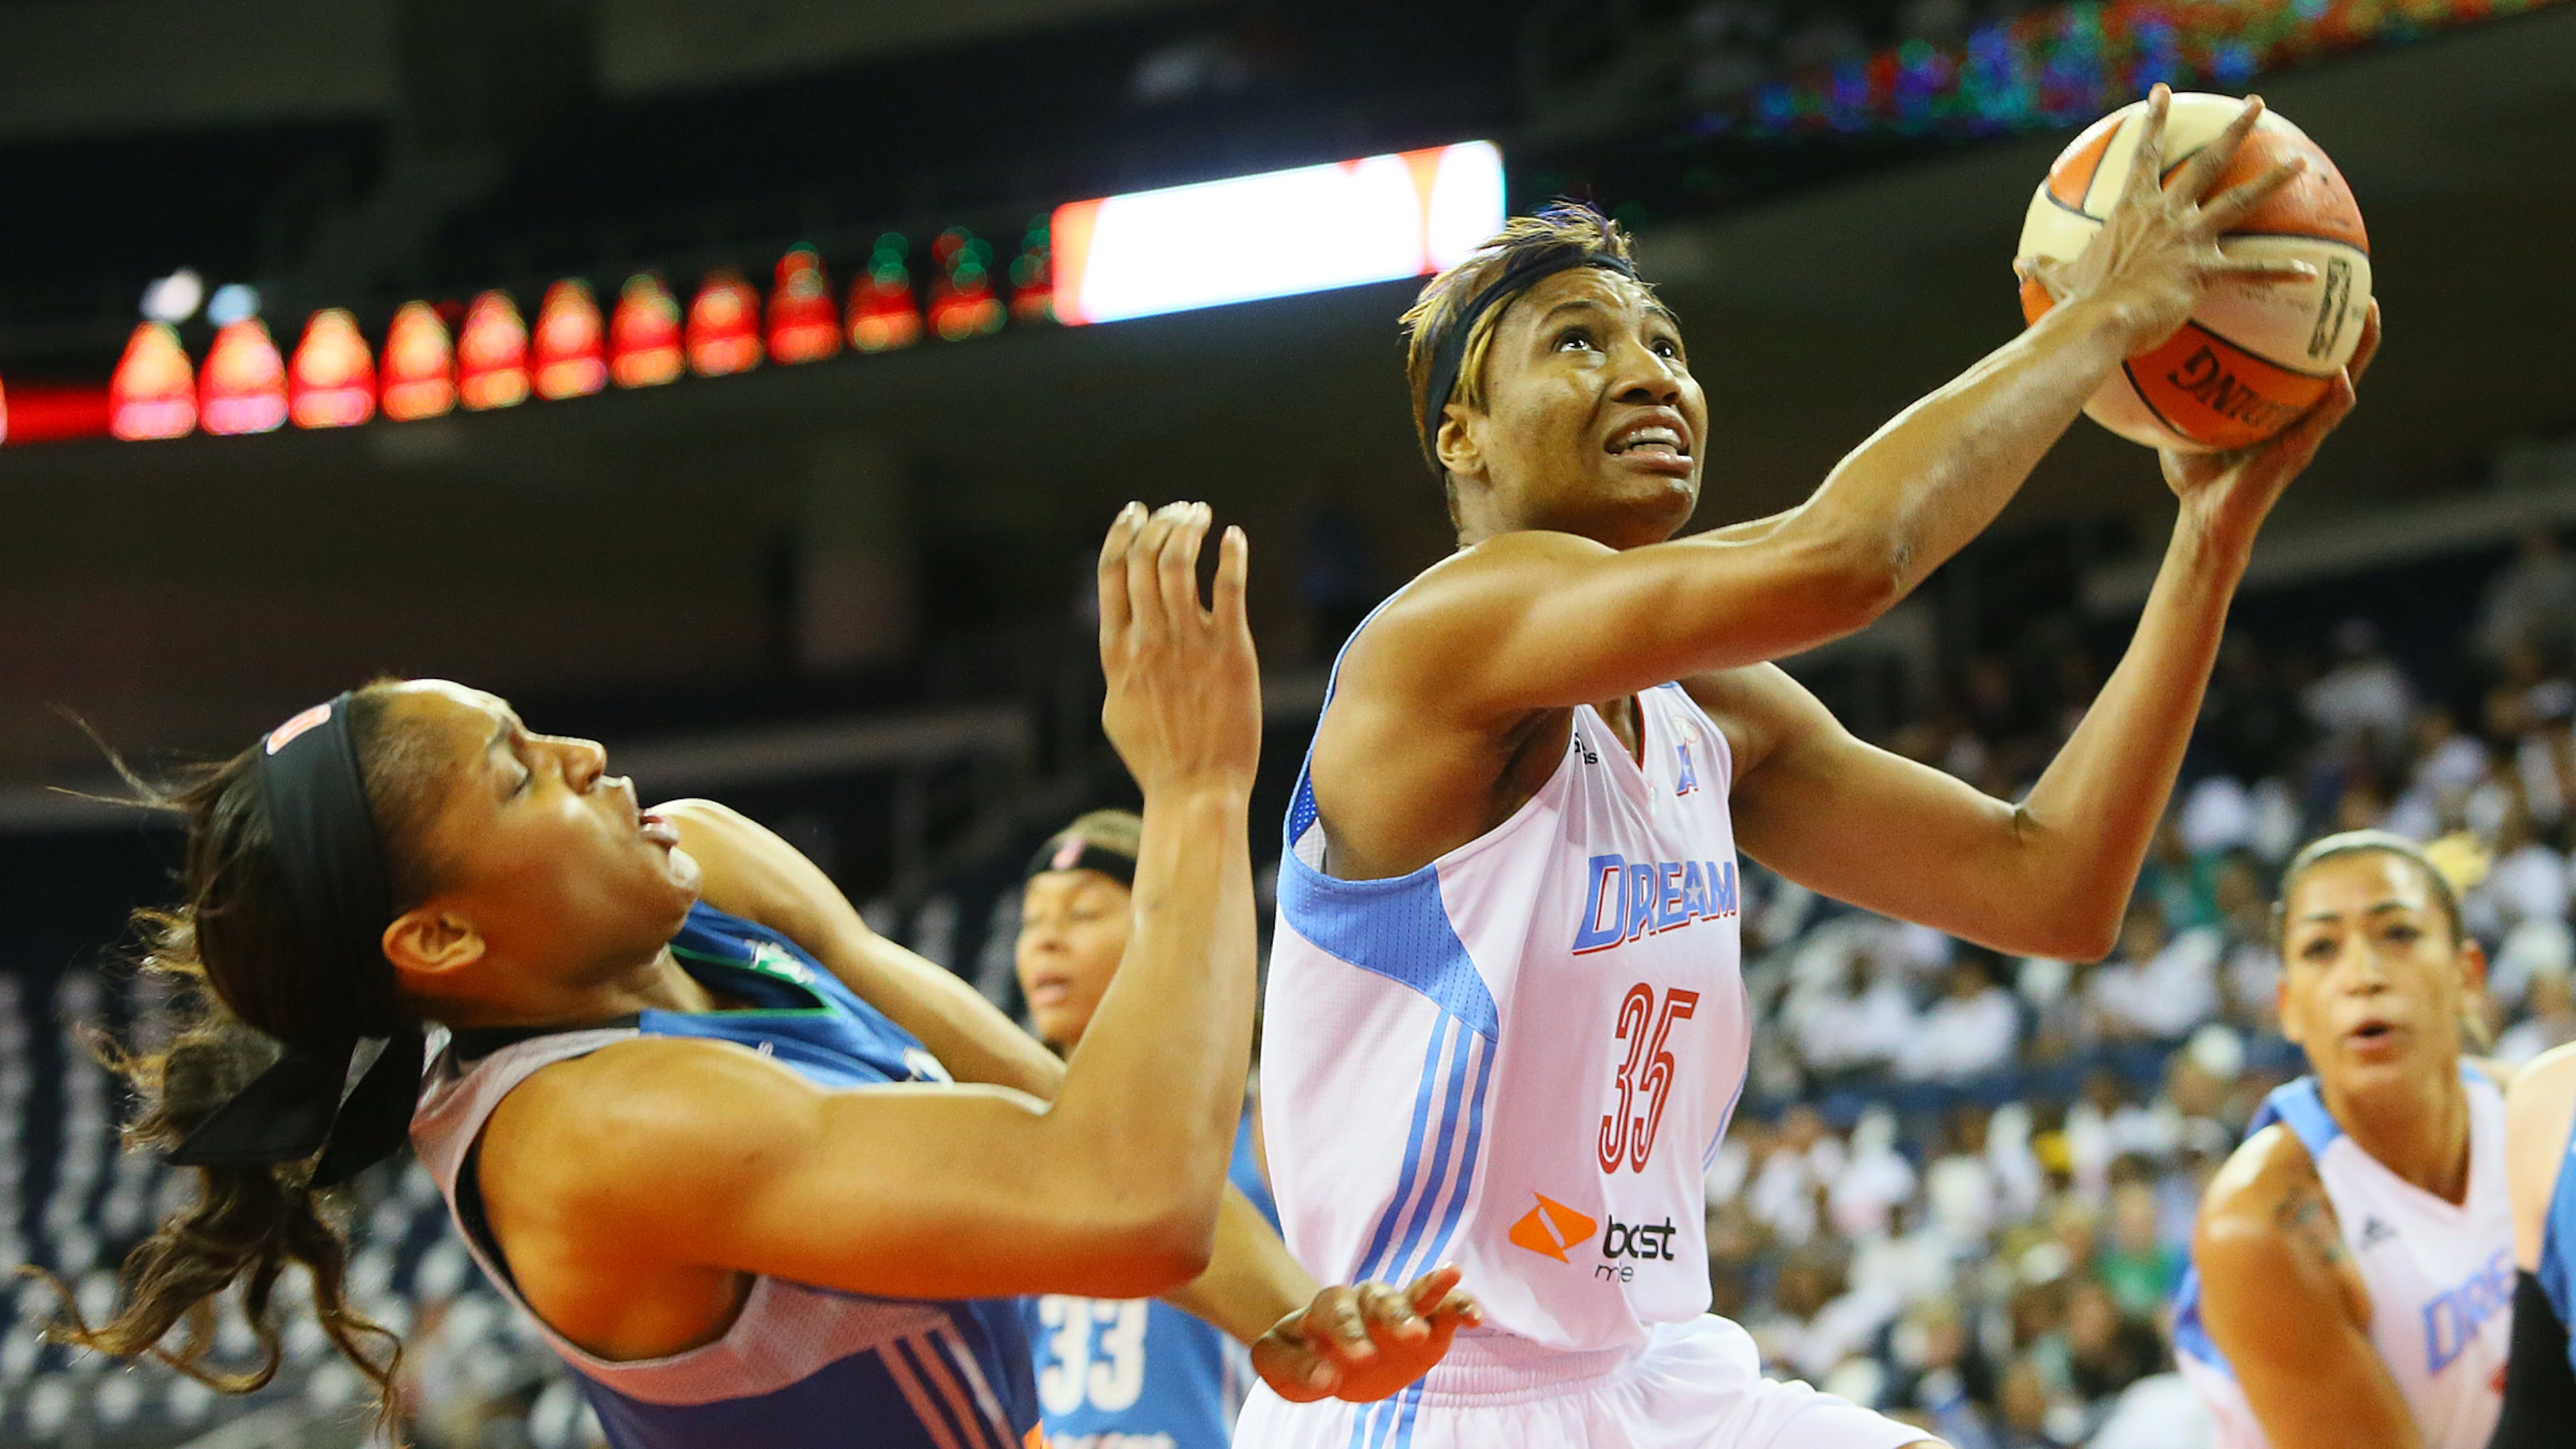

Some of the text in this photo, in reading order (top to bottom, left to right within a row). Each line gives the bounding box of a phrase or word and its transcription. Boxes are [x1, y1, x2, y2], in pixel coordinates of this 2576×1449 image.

[1572, 853, 1736, 956] DREAM
[1598, 983, 1699, 1174] 35
[1038, 1295, 1148, 1415] 33
